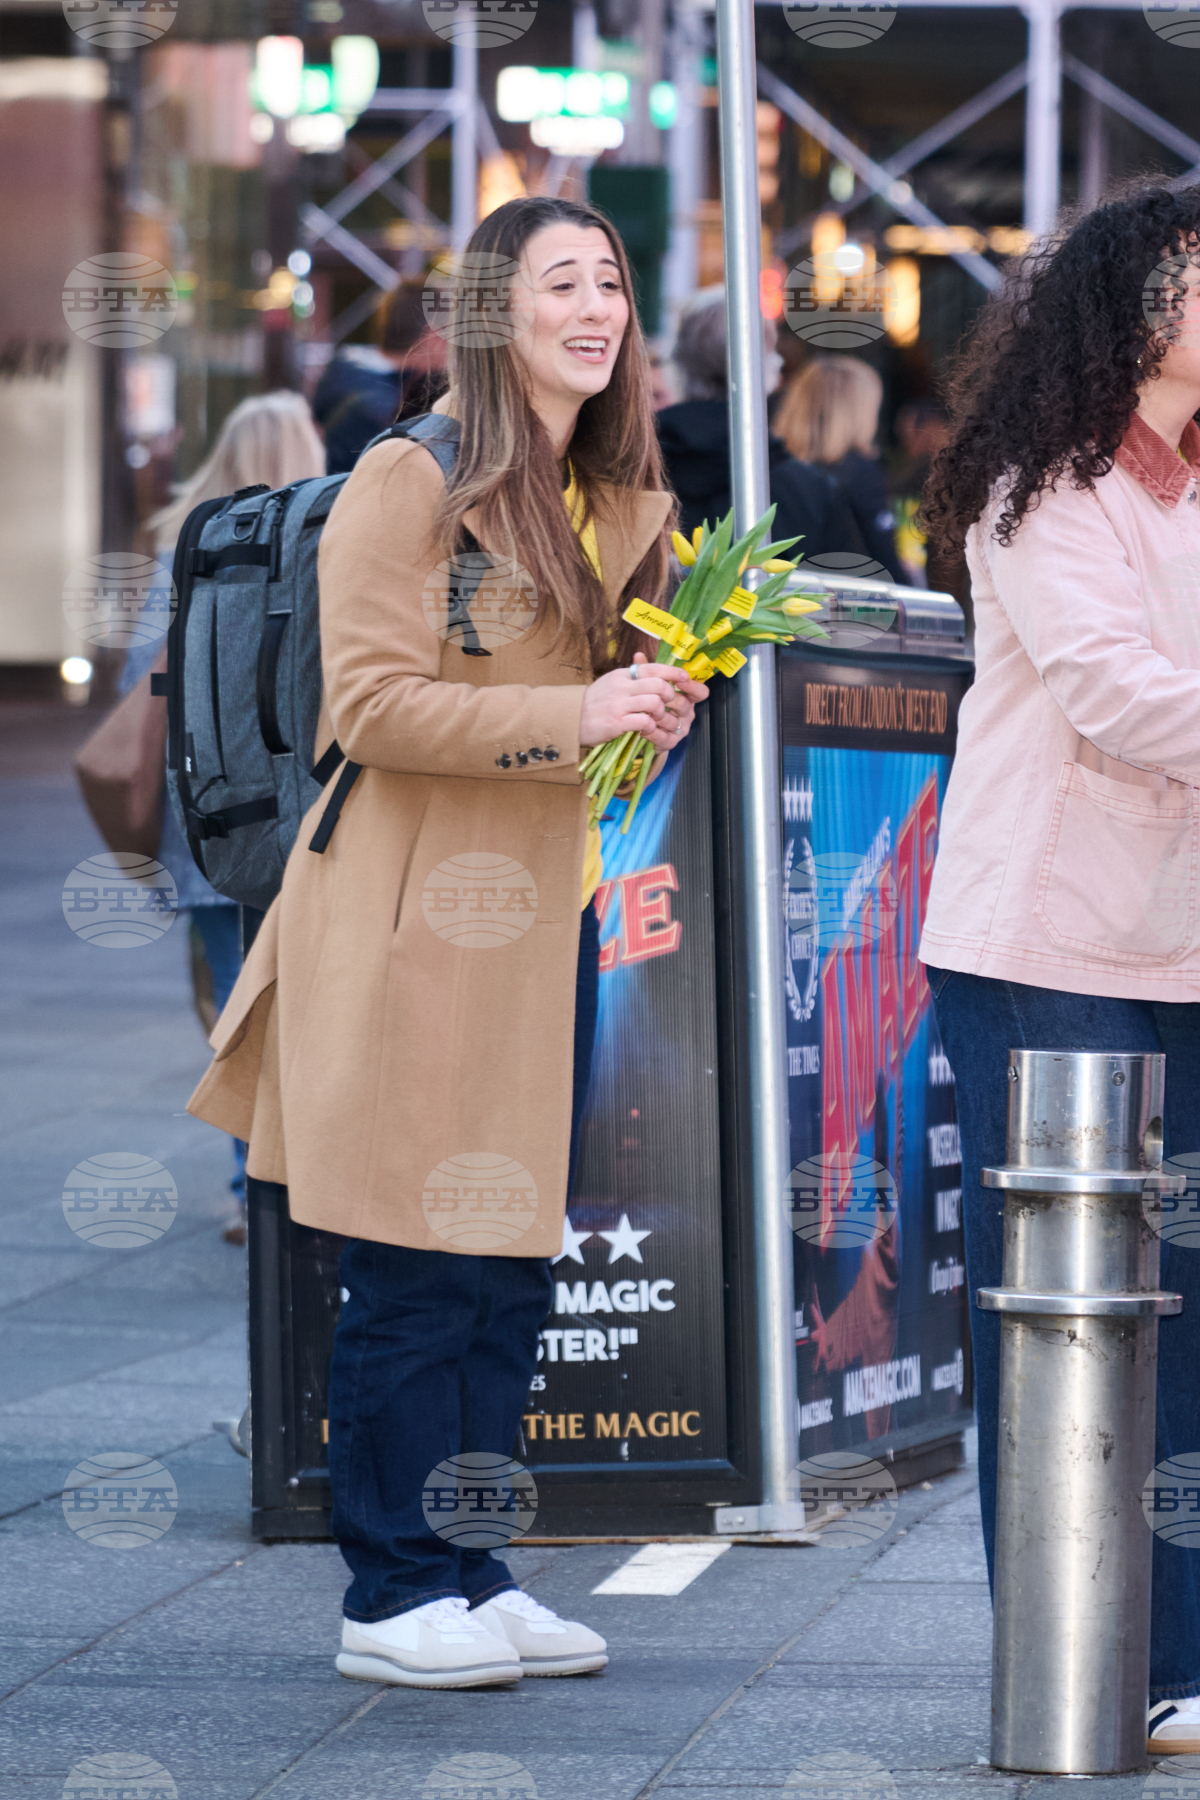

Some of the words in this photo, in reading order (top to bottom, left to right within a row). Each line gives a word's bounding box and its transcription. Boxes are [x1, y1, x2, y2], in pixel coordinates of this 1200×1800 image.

[634, 610, 675, 633] Amneal
[805, 682, 838, 726] DIRECT
[838, 684, 863, 728] FROM
[862, 681, 905, 730] LONDON'S
[905, 687, 930, 733] WEST
[929, 689, 949, 735] END
[788, 1046, 802, 1077] THE
[803, 1044, 821, 1075] TIMES
[554, 1278, 677, 1315] MAGIC
[842, 1353, 922, 1418] AMAZEMAGIC.COM
[522, 1412, 586, 1442] THE
[595, 1410, 702, 1440] MAGIC
